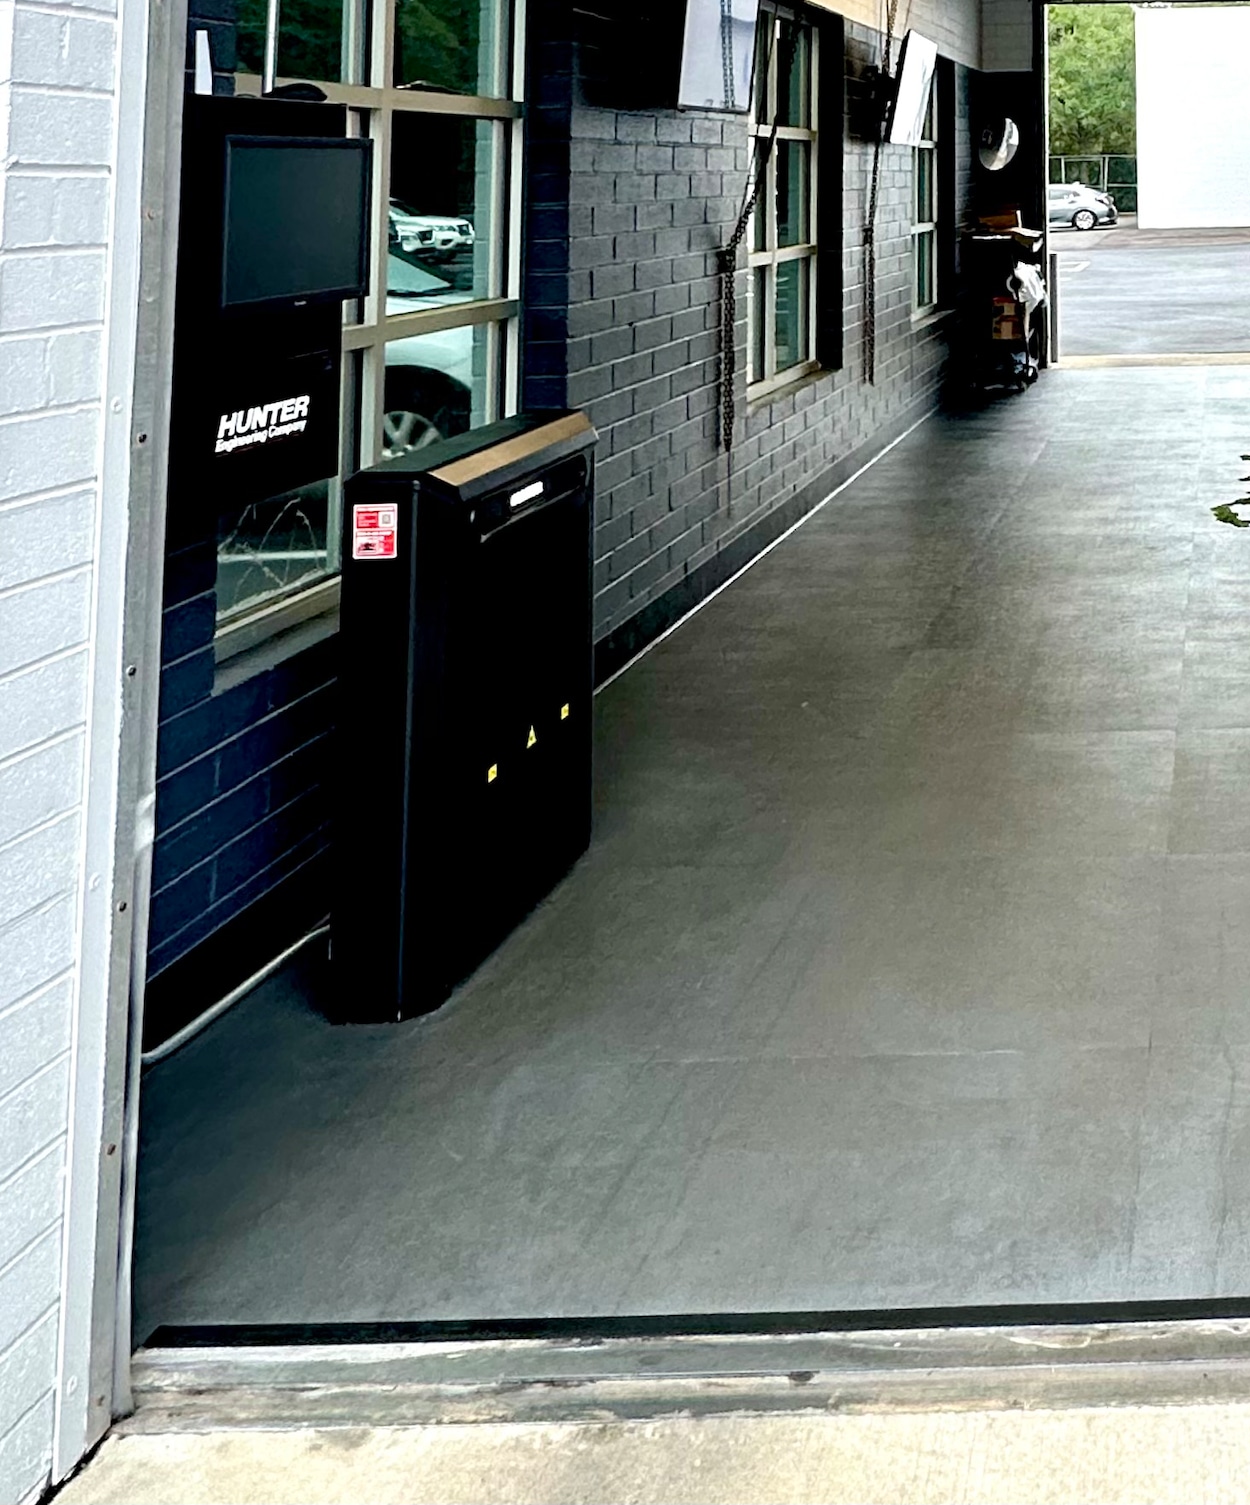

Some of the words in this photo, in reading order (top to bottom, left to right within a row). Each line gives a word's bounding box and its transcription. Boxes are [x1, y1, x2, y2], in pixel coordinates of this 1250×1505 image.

[217, 395, 310, 439] HUNTER
[215, 430, 268, 453] Engineering
[268, 420, 307, 438] Company
